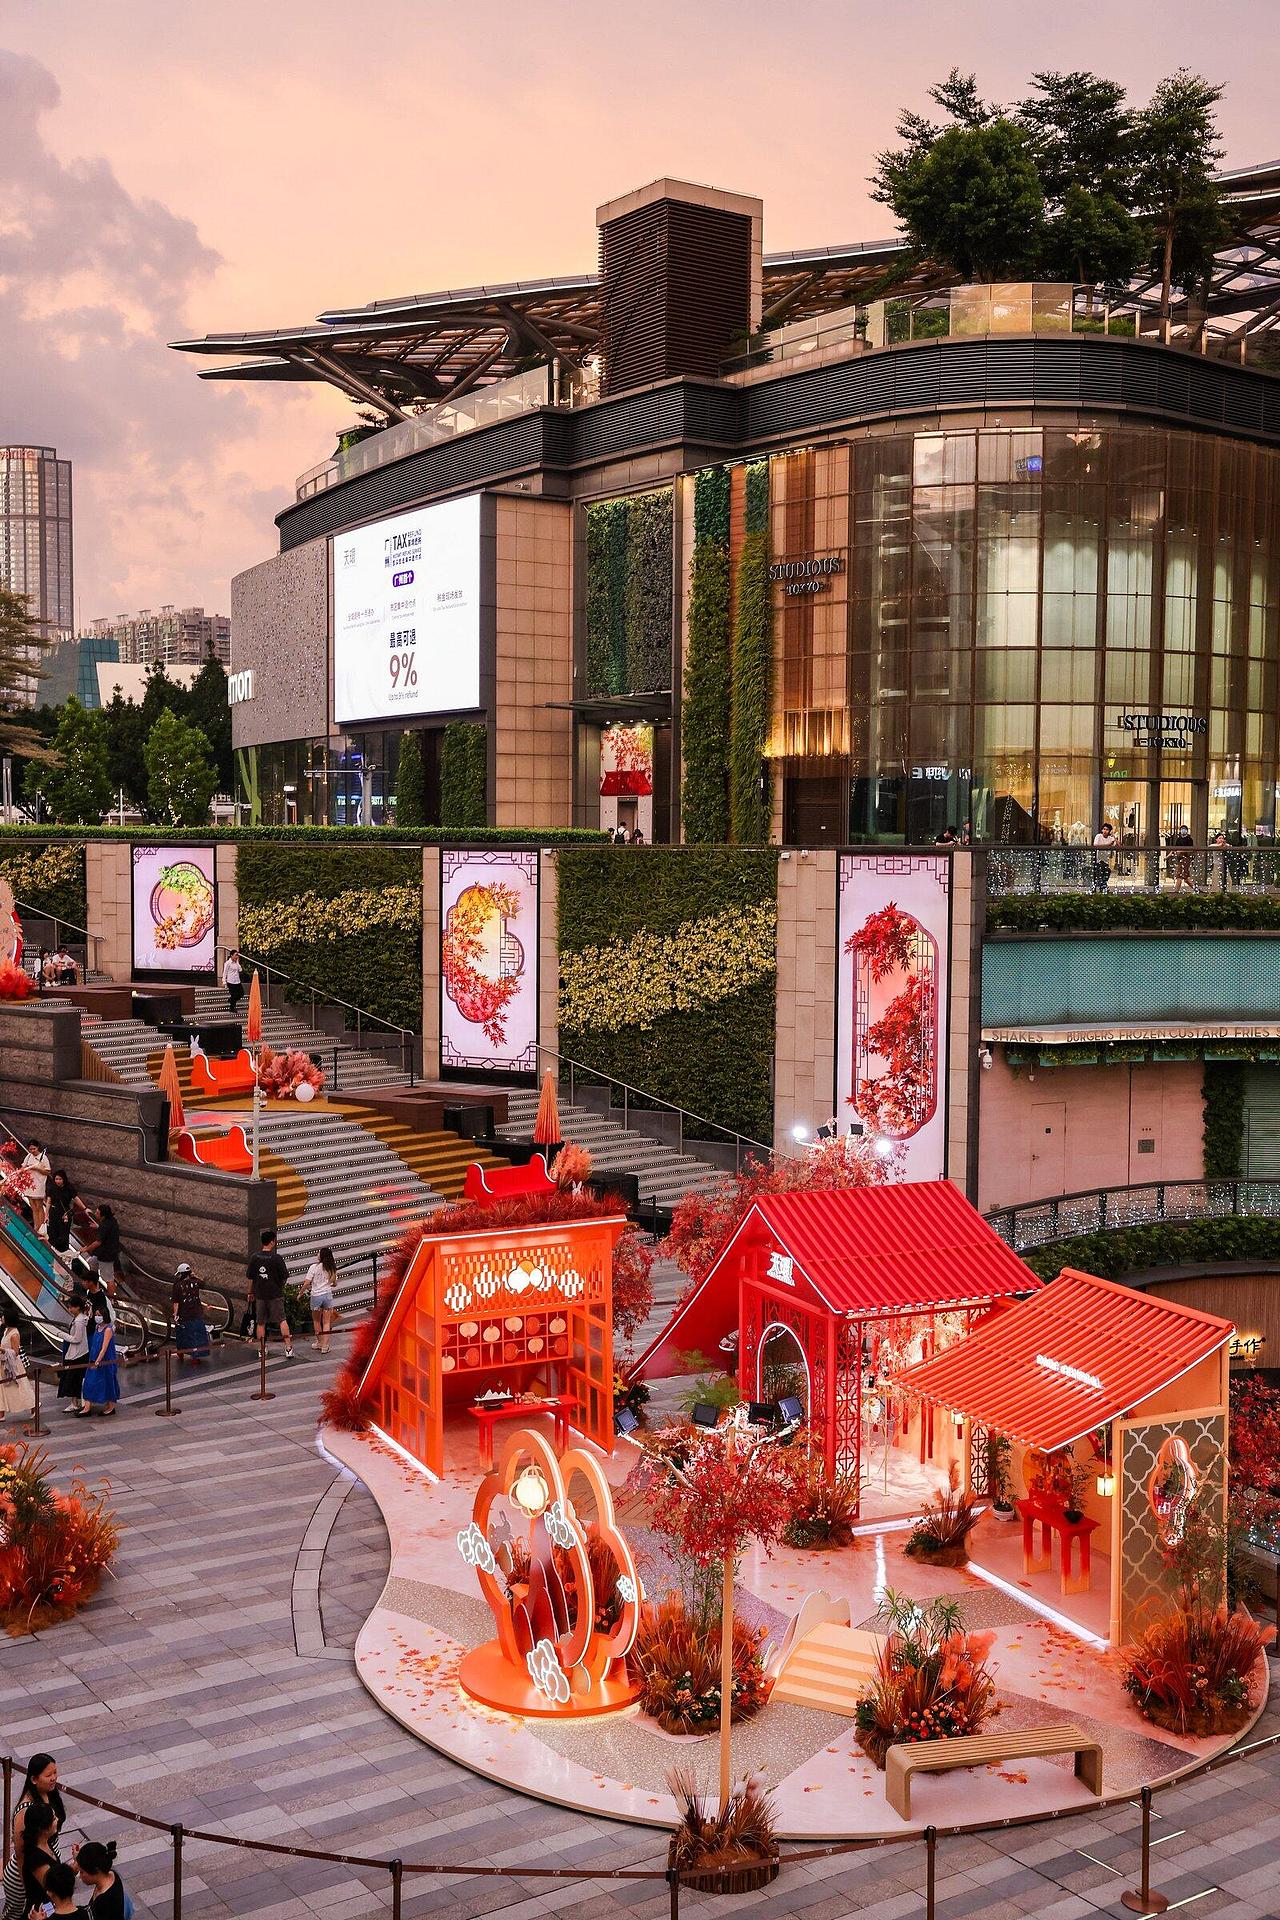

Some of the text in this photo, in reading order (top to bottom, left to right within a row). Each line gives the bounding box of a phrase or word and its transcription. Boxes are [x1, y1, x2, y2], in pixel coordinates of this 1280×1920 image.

[393, 533, 408, 551] TAX
[769, 557, 842, 580] STUDIOUS
[390, 652, 417, 688] 9%
[1124, 715, 1208, 734] STUDIOUS
[991, 1030, 1044, 1042] SHAKES
[1066, 1029, 1114, 1042] BURGERS
[1120, 1029, 1166, 1039] FROZEN
[1169, 1026, 1229, 1038] CUSTARD
[1234, 1026, 1270, 1038] FRIES
